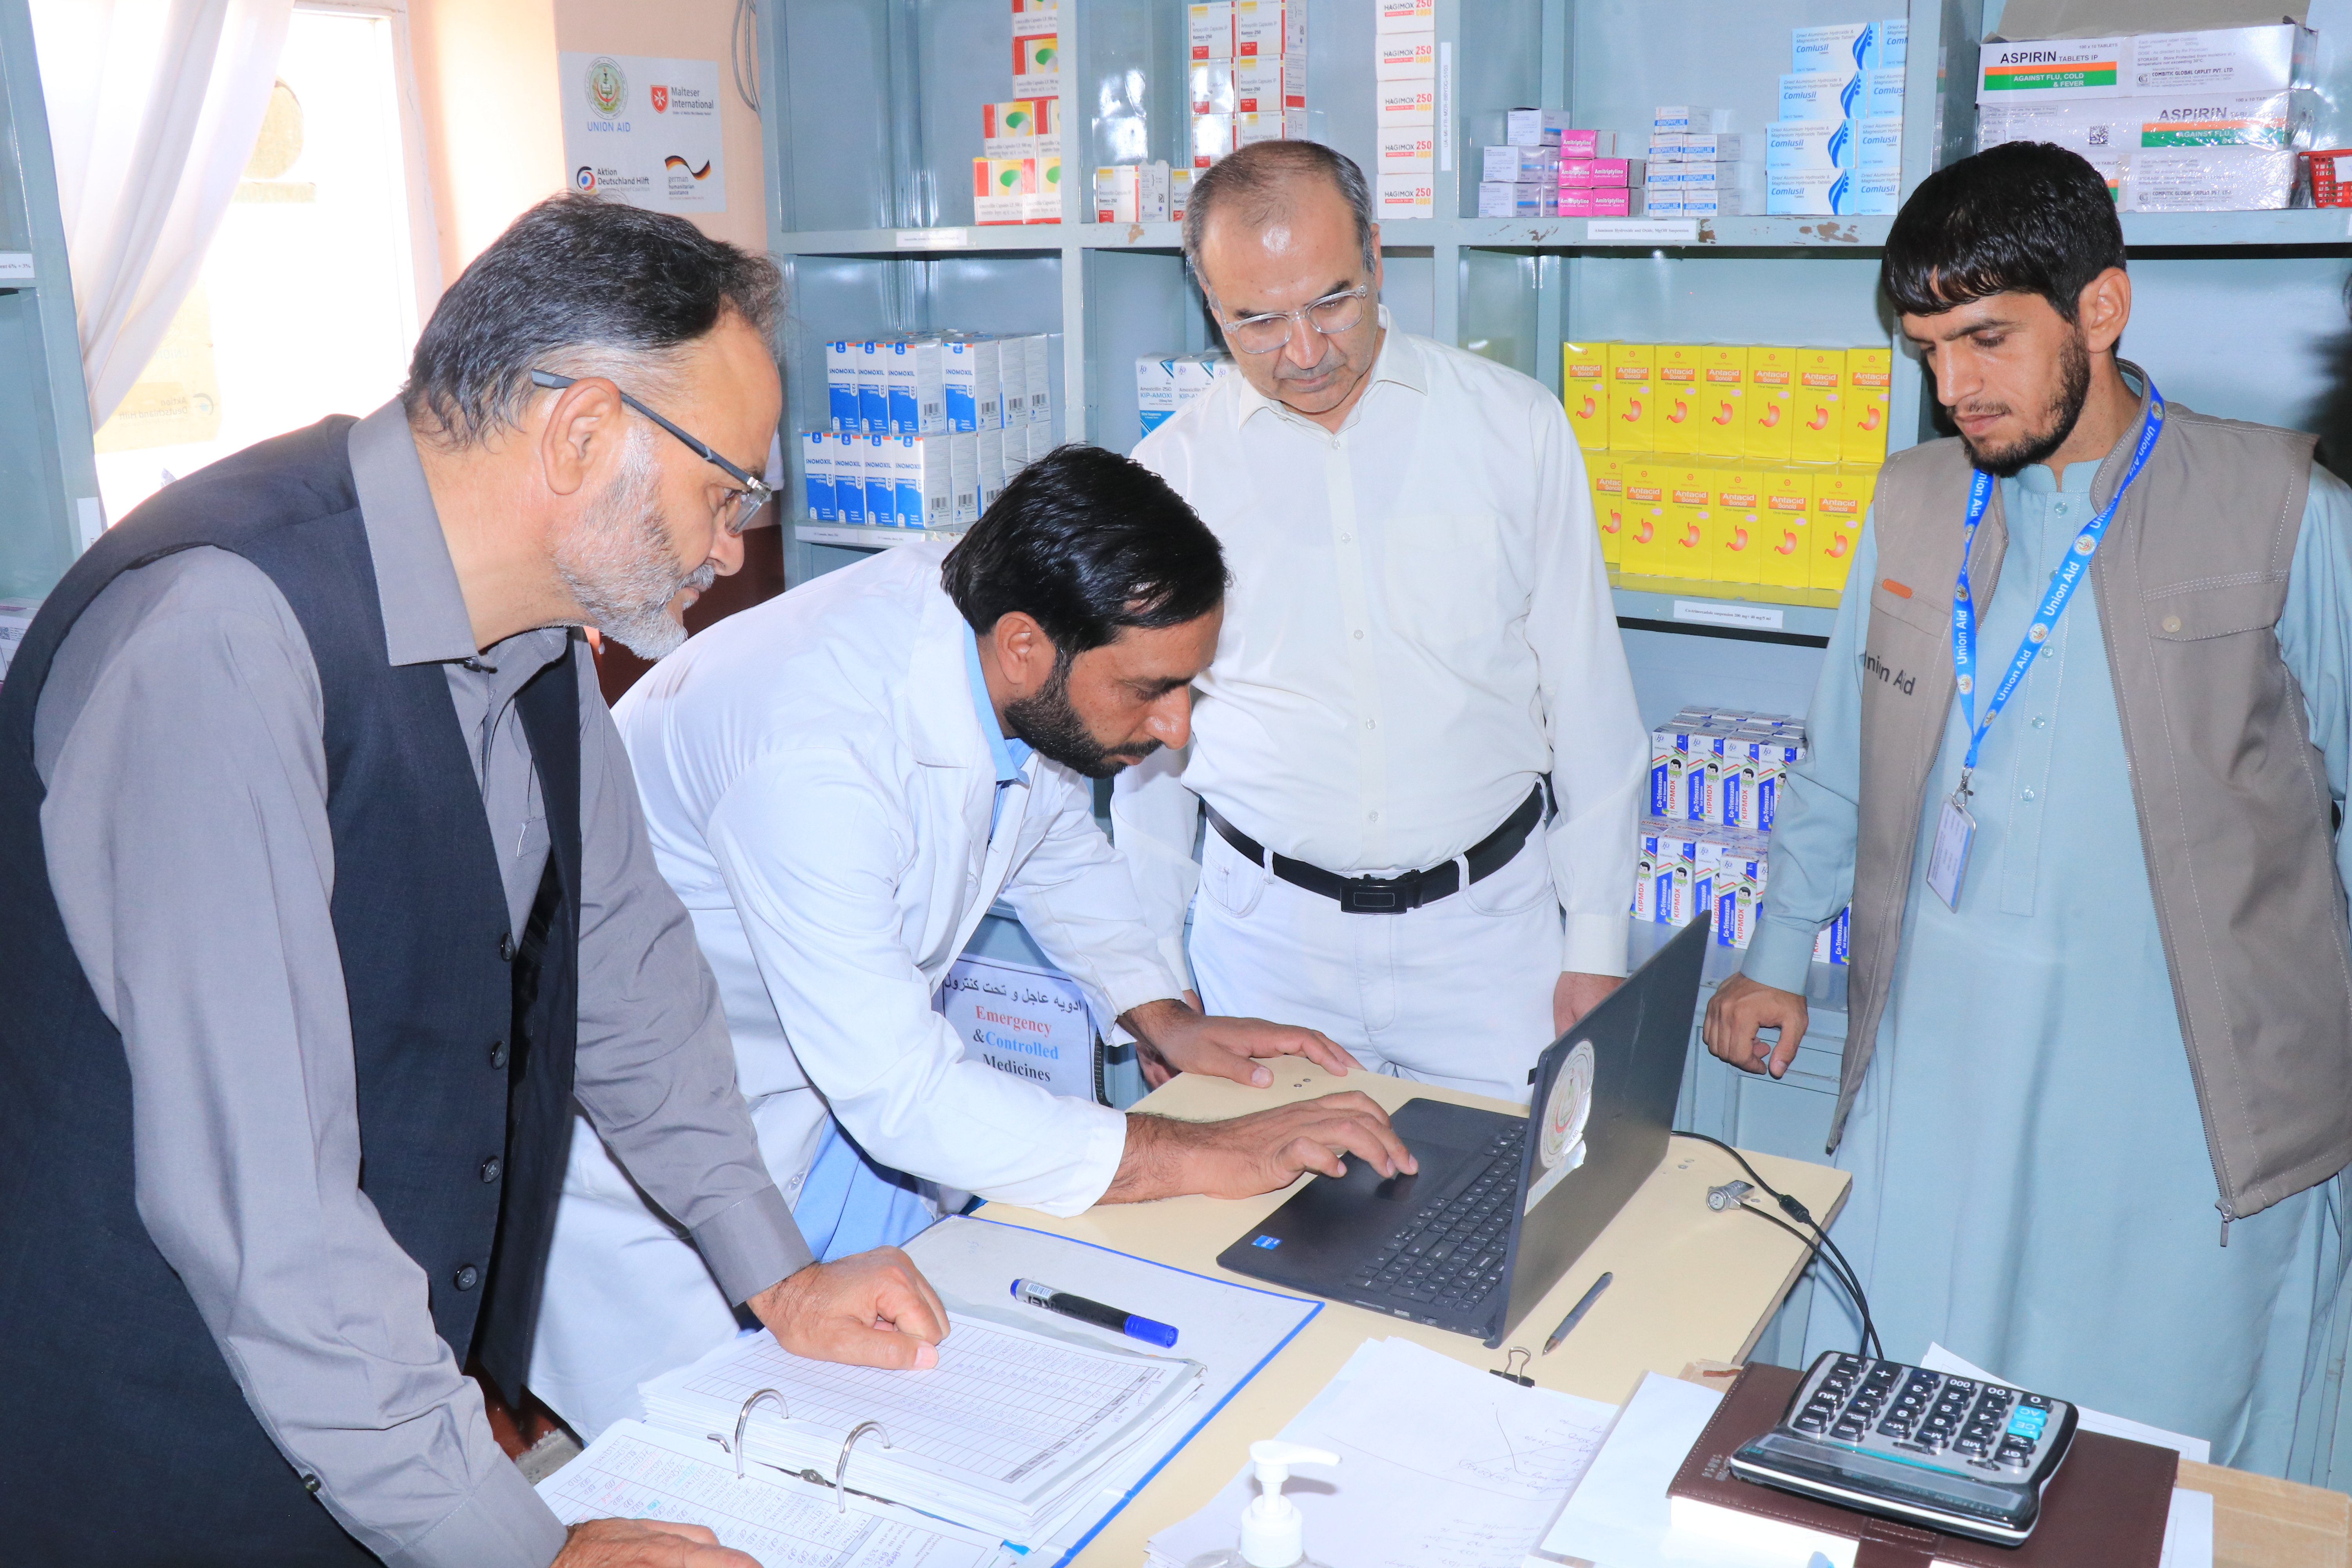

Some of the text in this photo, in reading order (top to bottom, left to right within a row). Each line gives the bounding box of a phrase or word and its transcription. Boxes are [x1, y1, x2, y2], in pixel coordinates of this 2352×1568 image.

[1416, 46, 1432, 55] 250
[1797, 44, 1829, 53] Comlusil
[2000, 51, 2056, 64] ASPIRIN
[671, 87, 700, 97] Malteser
[1416, 94, 1432, 103] 250
[672, 99, 714, 109] International
[2159, 107, 2227, 120] ASPIRIN
[588, 122, 631, 132] UNION AID
[1863, 136, 1896, 144] Comlusil
[1416, 141, 1432, 150] 250
[1416, 188, 1431, 197] 250
[2138, 425, 2156, 456] Union
[1970, 472, 1988, 517] nion Aid
[1771, 496, 1804, 504] Antacid
[2043, 561, 2080, 617] Union Aid
[1956, 610, 1967, 664] Union Aid
[1997, 650, 2032, 701] Union Aid
[983, 983, 1006, 996] تحت
[1011, 991, 1018, 1002] و
[1022, 988, 1049, 1005] عاجل
[975, 1005, 1052, 1038] Emergency
[973, 1028, 1059, 1060] &Controlled
[983, 1053, 1051, 1082] Medicines
[1818, 1392, 1837, 1401] MU
[2020, 1408, 2040, 1416] AC
[2016, 1421, 2036, 1430] CE
